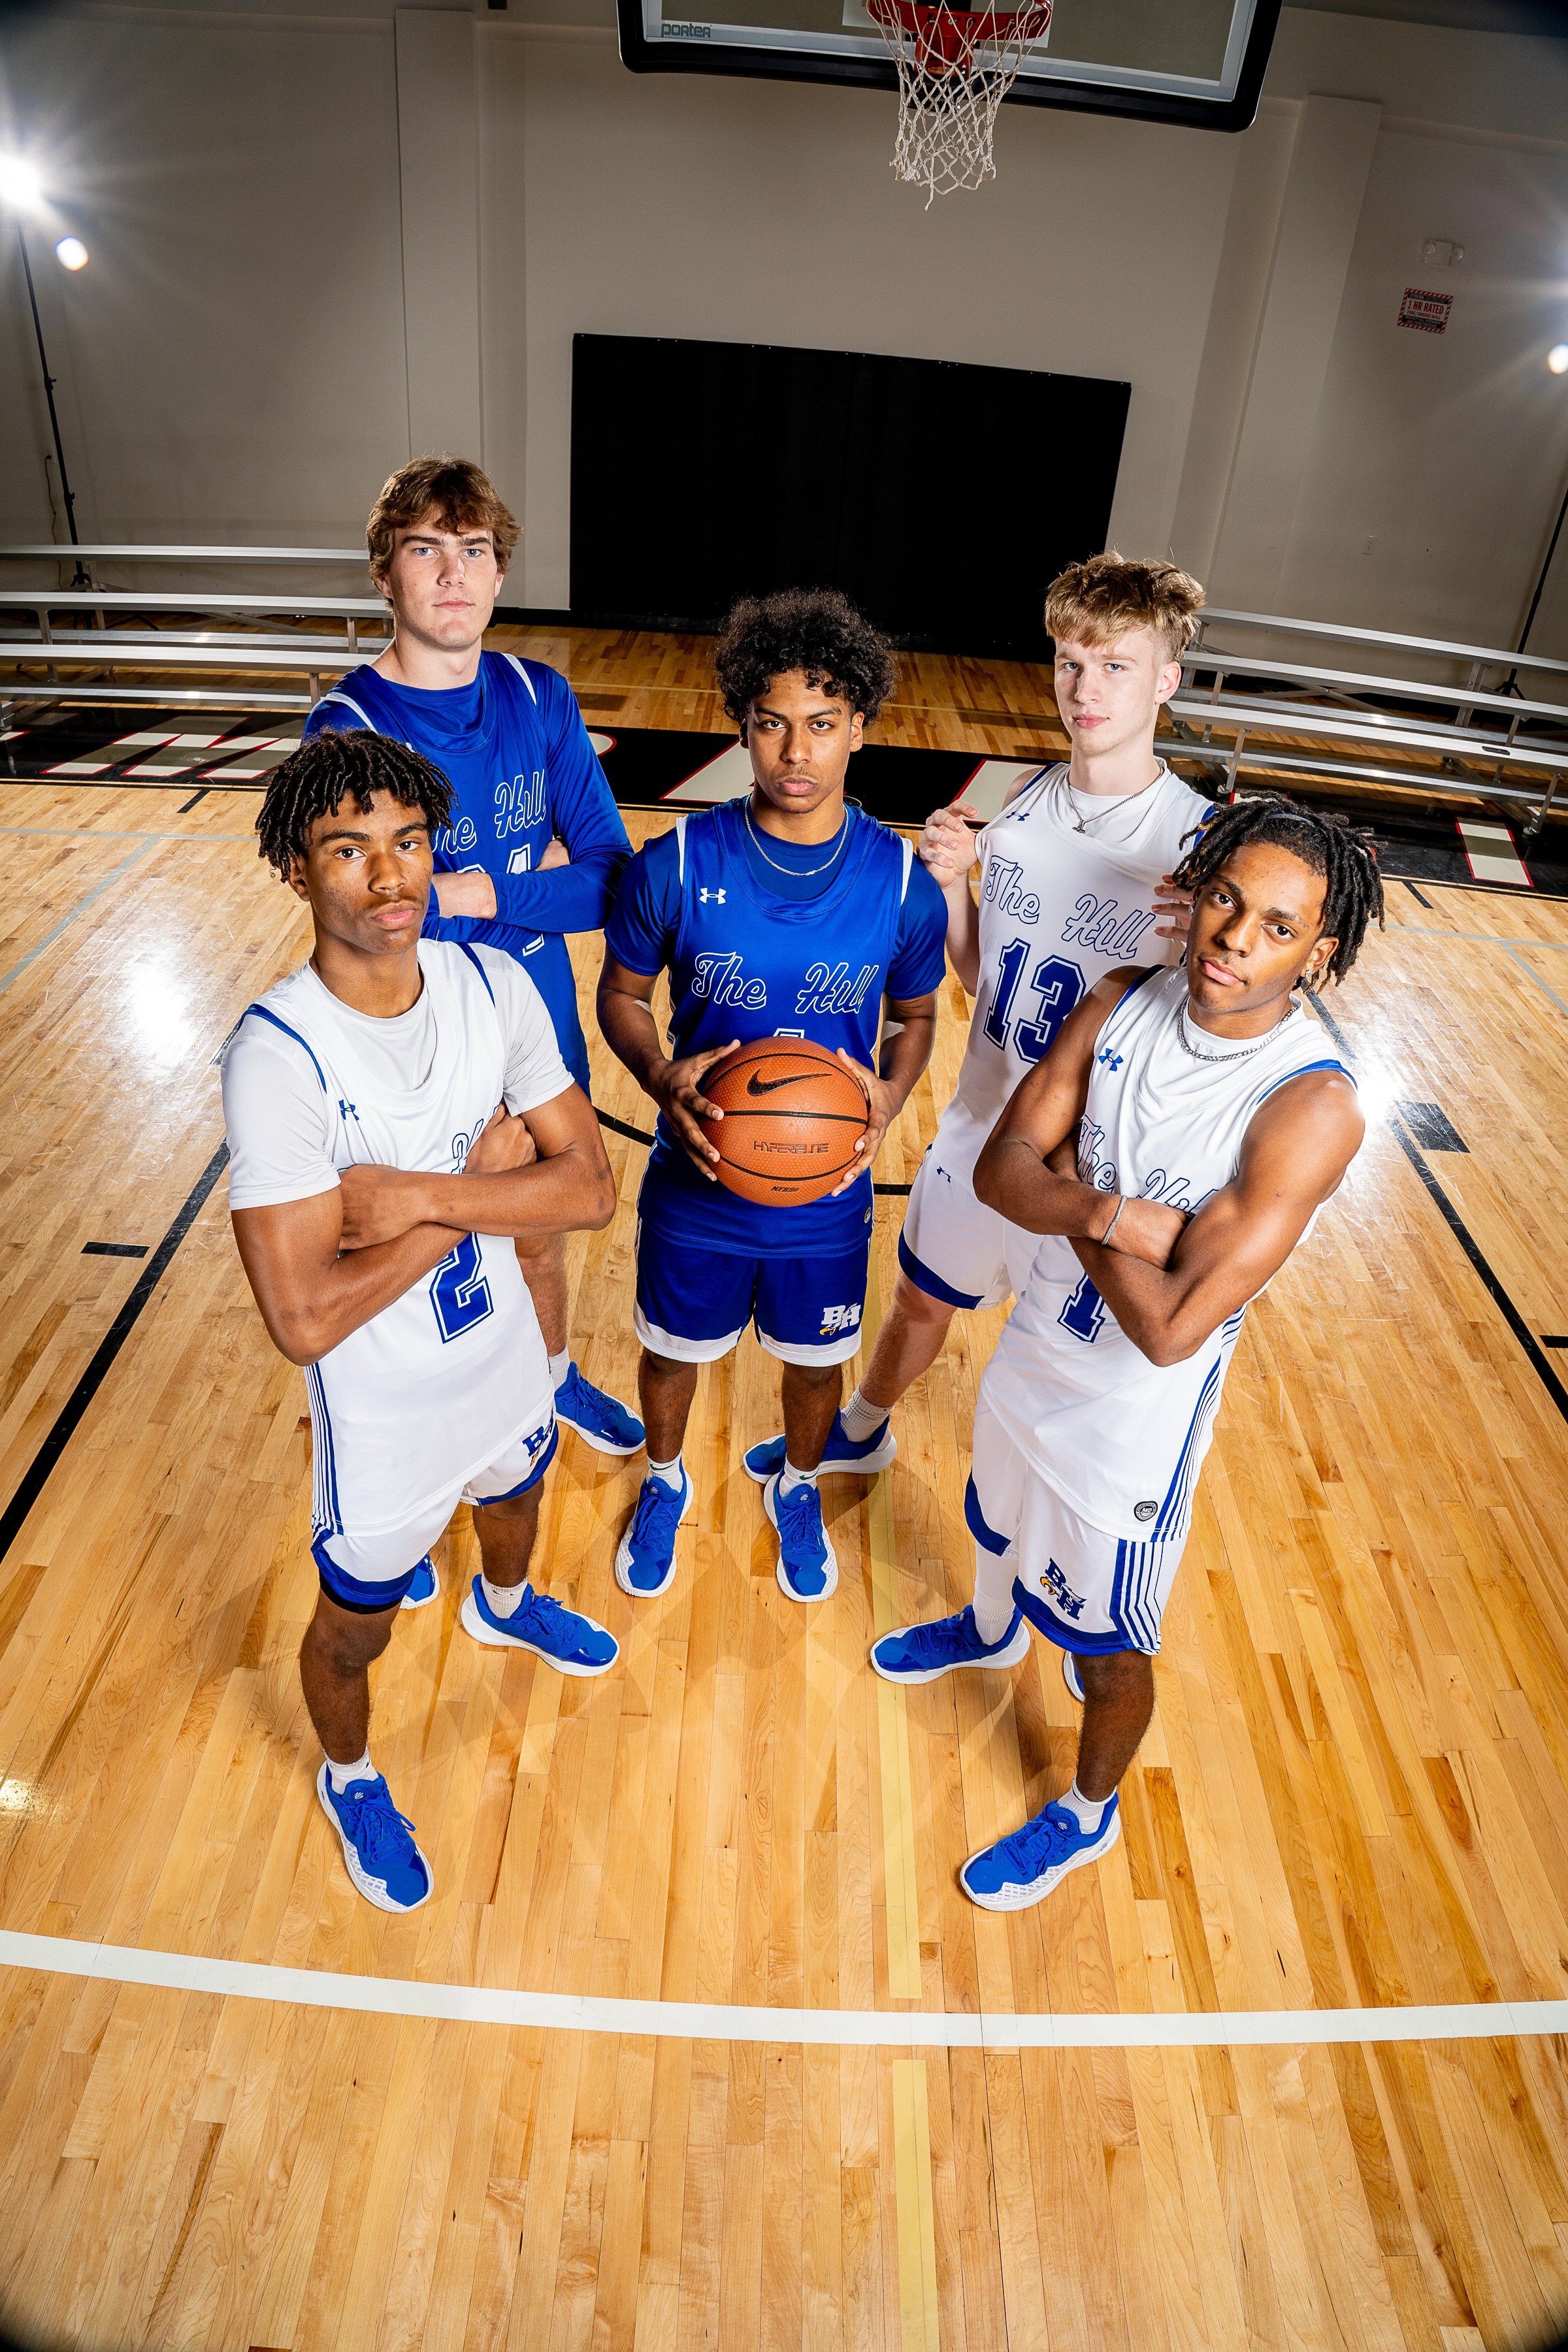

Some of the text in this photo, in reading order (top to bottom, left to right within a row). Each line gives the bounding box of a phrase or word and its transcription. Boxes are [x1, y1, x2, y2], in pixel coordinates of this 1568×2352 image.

[1407, 301, 1444, 314] 1 HR RATED
[984, 855, 1156, 960] The Hill
[691, 951, 879, 1014] The Hill
[983, 937, 1087, 1066] 13
[429, 1232, 494, 1344] 2
